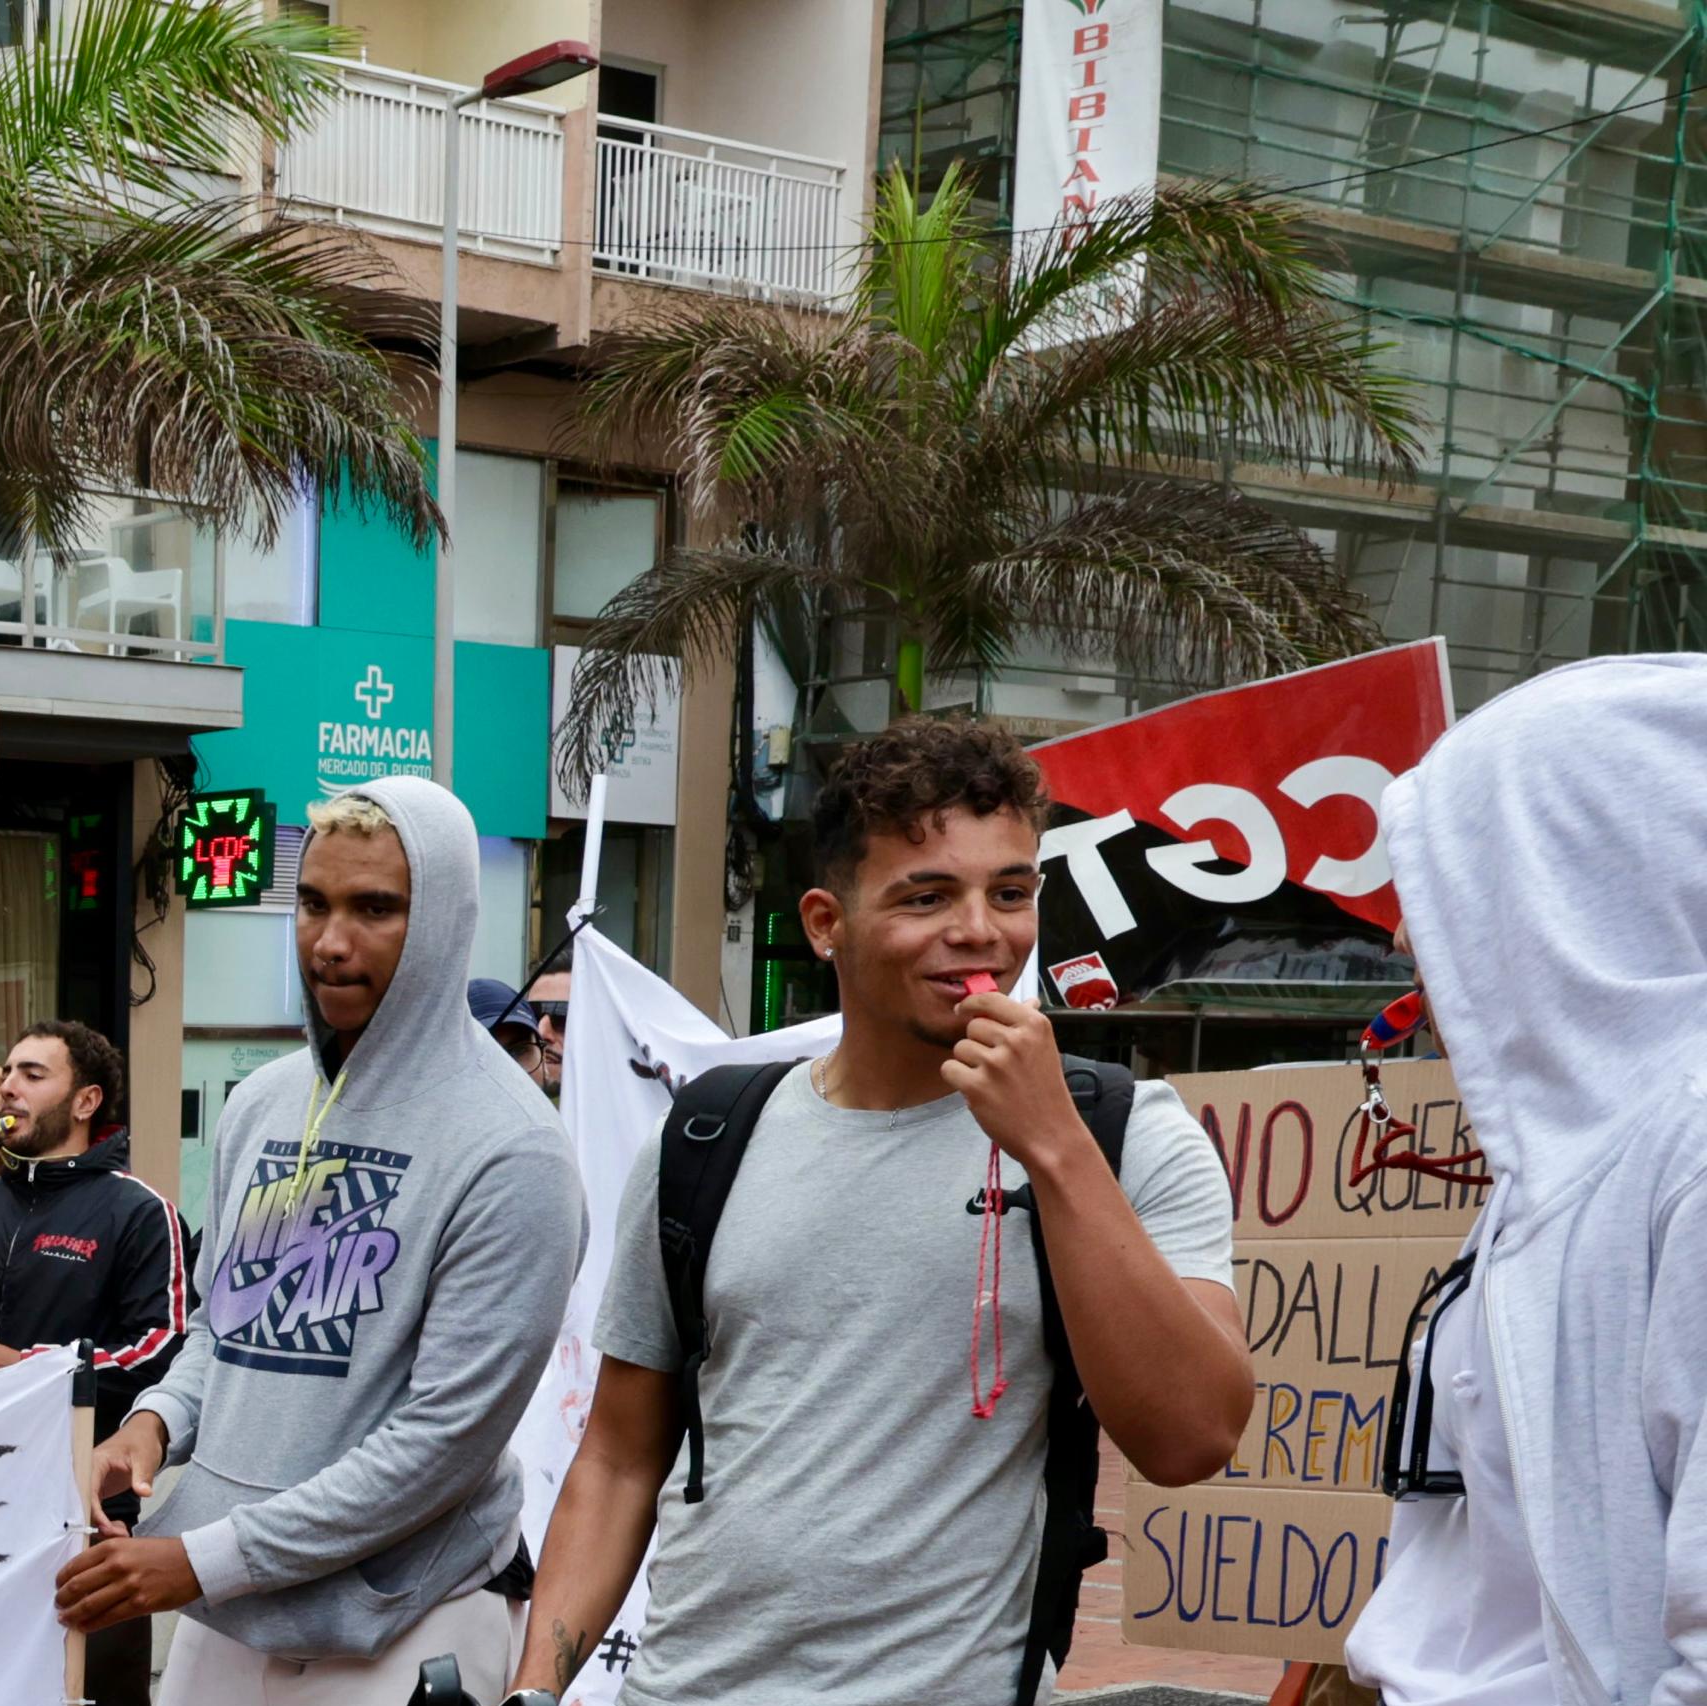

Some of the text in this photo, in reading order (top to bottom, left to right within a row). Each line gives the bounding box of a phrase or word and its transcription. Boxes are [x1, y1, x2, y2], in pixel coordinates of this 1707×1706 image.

[318, 721, 432, 761] FARMACIA
[318, 758, 368, 777] MERCADO
[369, 760, 389, 779] DEL
[276, 1226, 401, 1335] AIR
[1134, 1505, 1358, 1629] SUELDO
